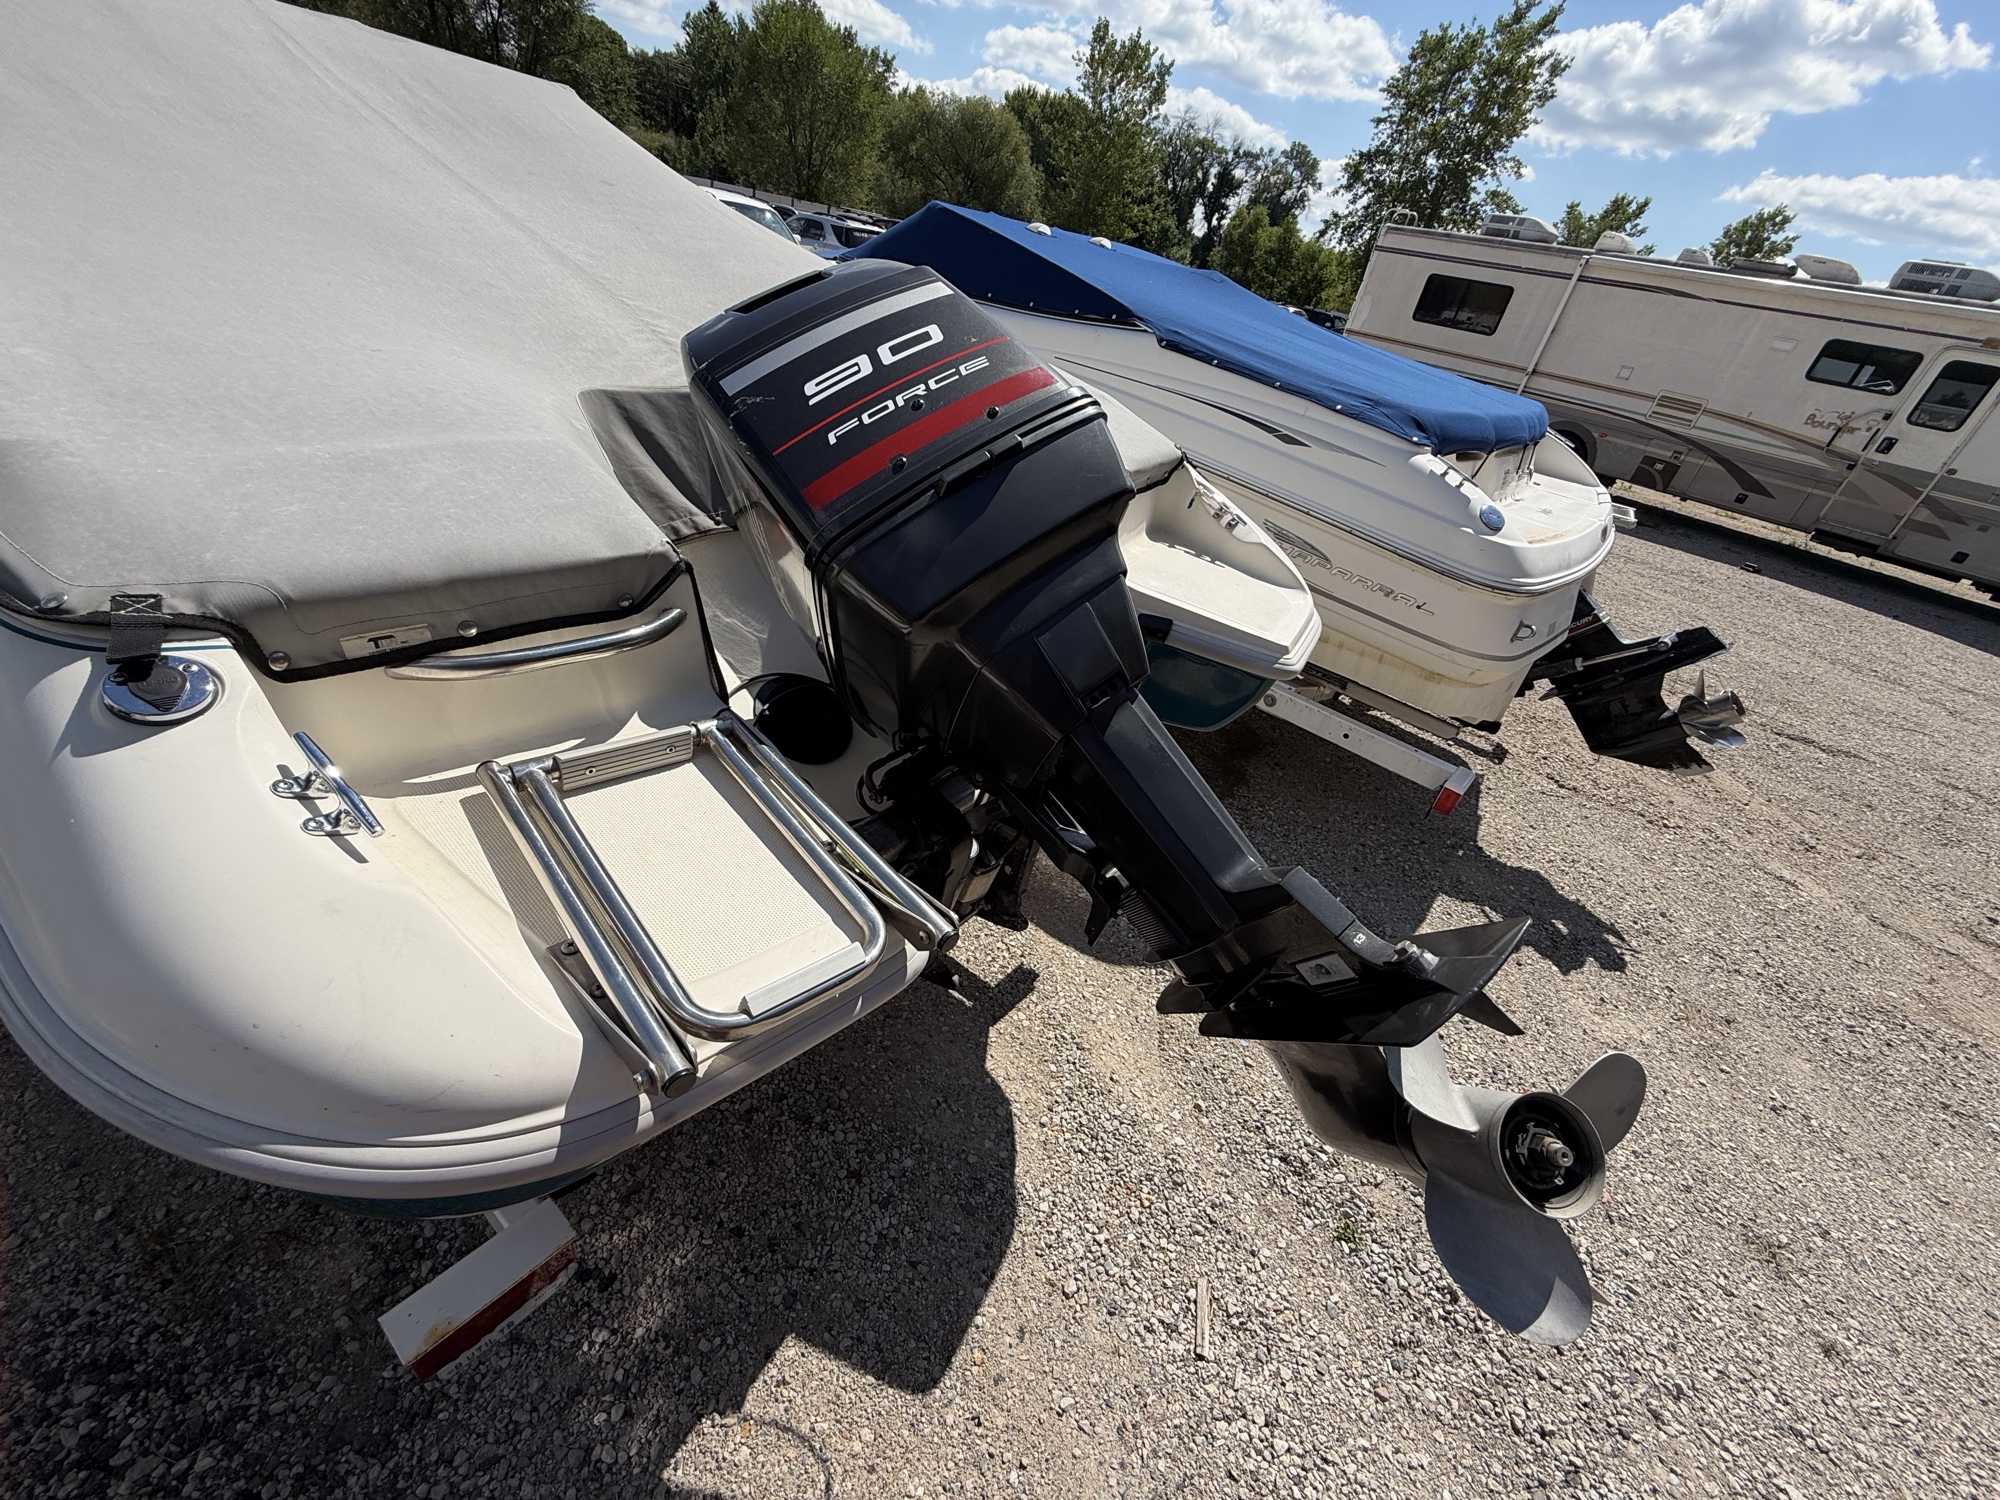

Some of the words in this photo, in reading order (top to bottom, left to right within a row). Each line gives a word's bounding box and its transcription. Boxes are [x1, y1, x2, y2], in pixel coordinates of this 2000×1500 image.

[804, 324, 944, 405] 90
[827, 355, 990, 445] FORCE
[1277, 541, 1434, 616] HAPARRAL
[1571, 614, 1594, 628] CURY
